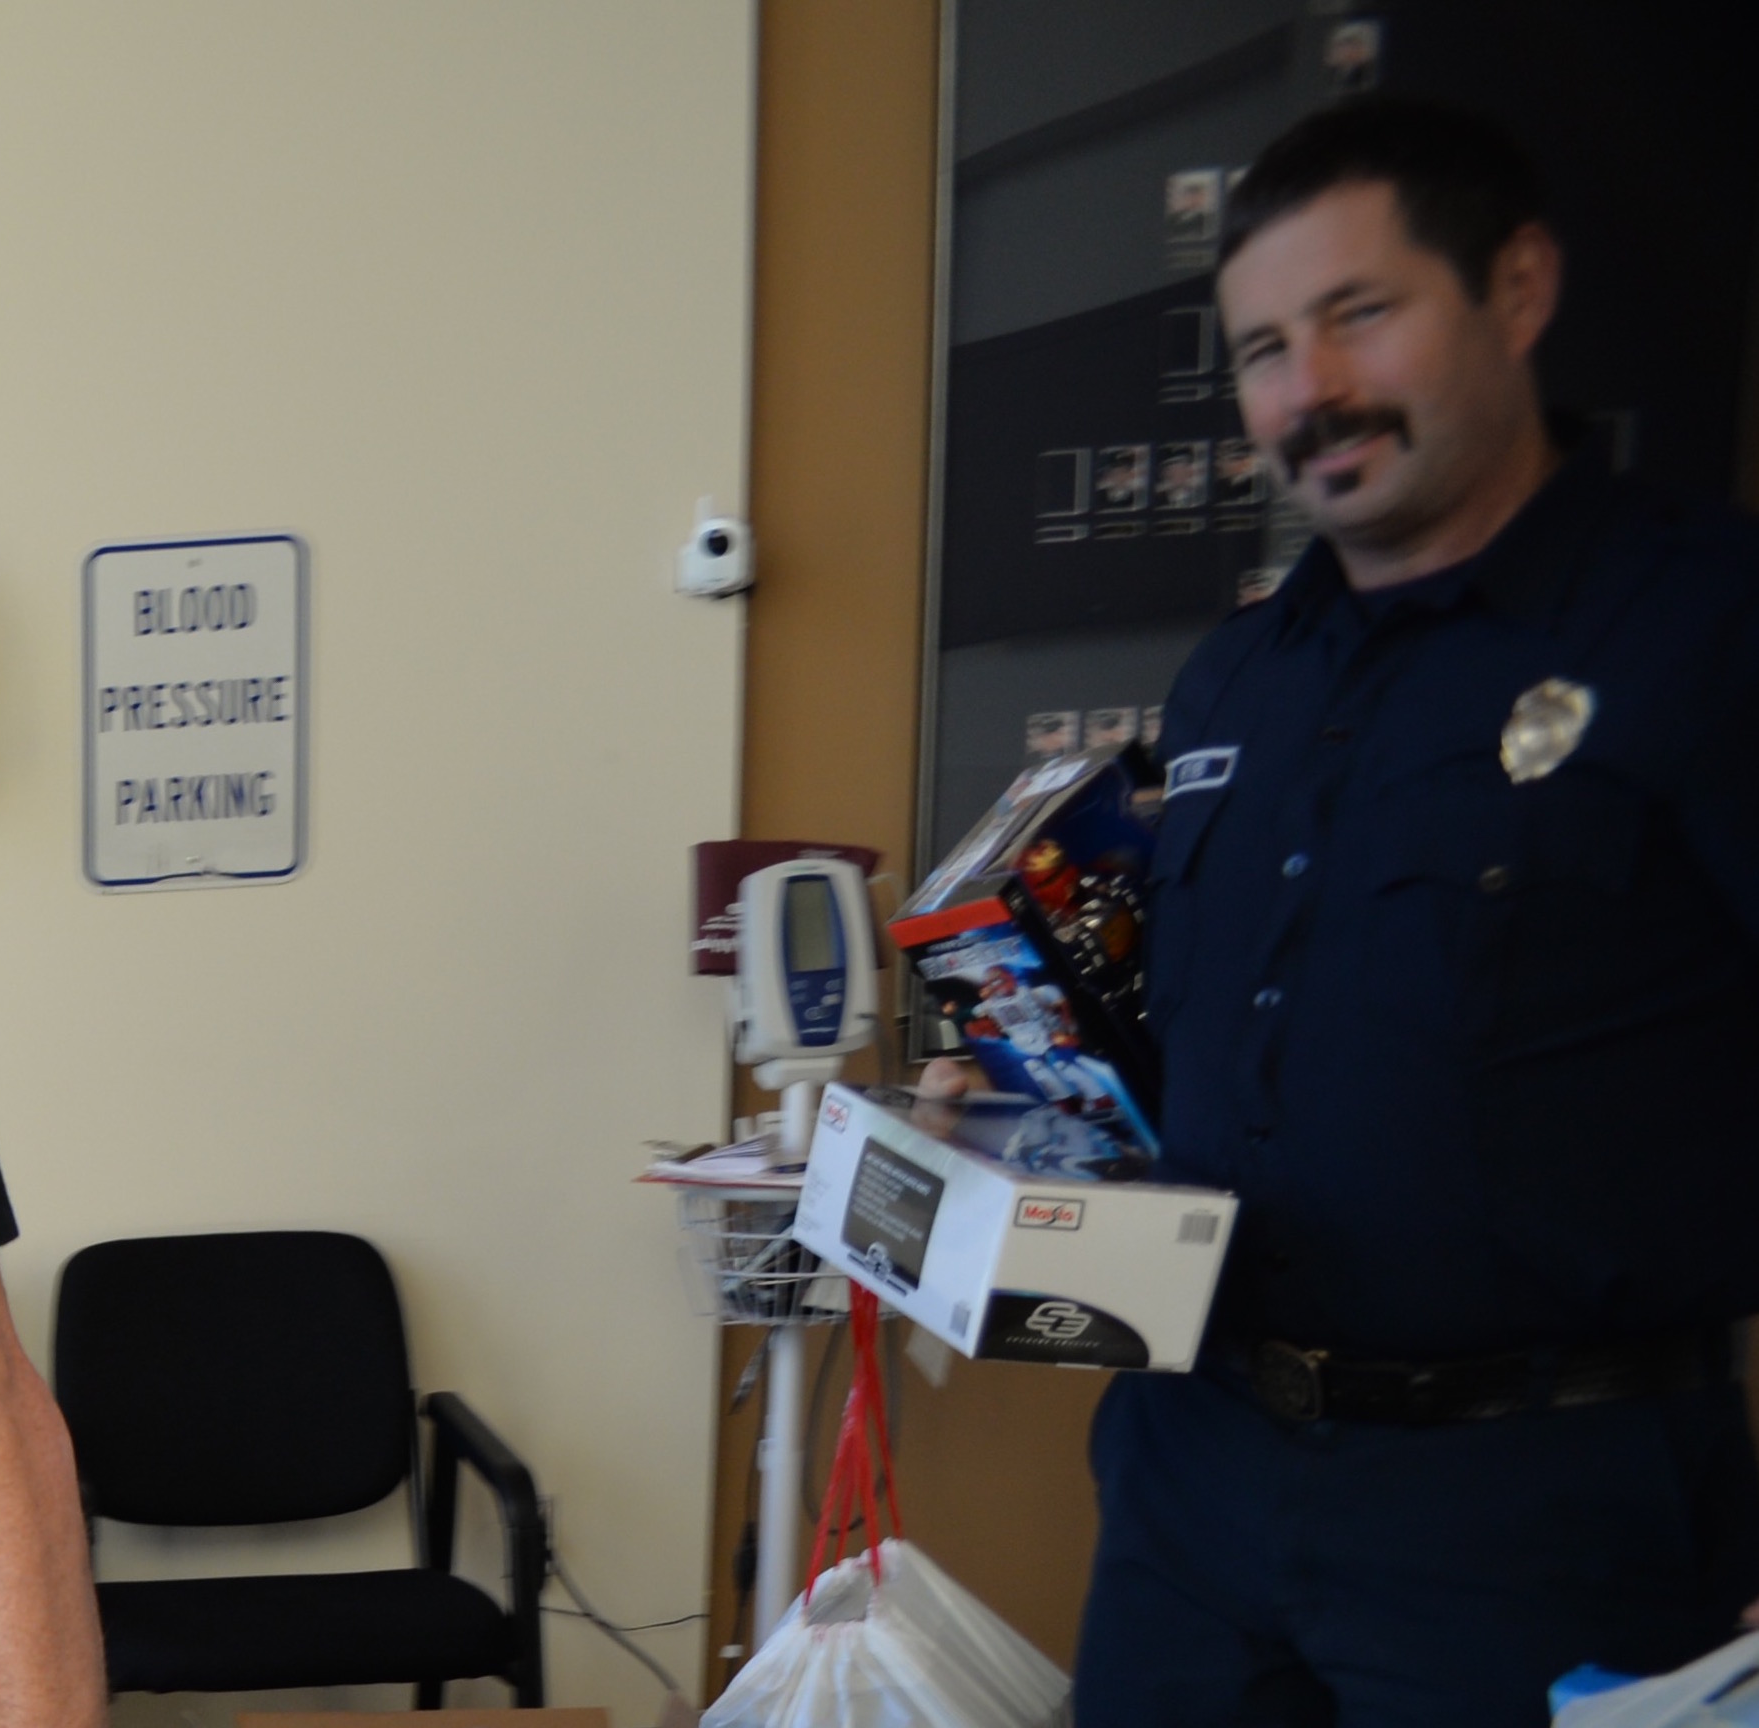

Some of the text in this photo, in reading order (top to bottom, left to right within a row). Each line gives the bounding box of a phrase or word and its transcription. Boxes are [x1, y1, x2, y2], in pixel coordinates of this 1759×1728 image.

[131, 582, 258, 637] BLOOD
[97, 674, 293, 733] PRESSURE
[114, 770, 277, 826] PARKING
